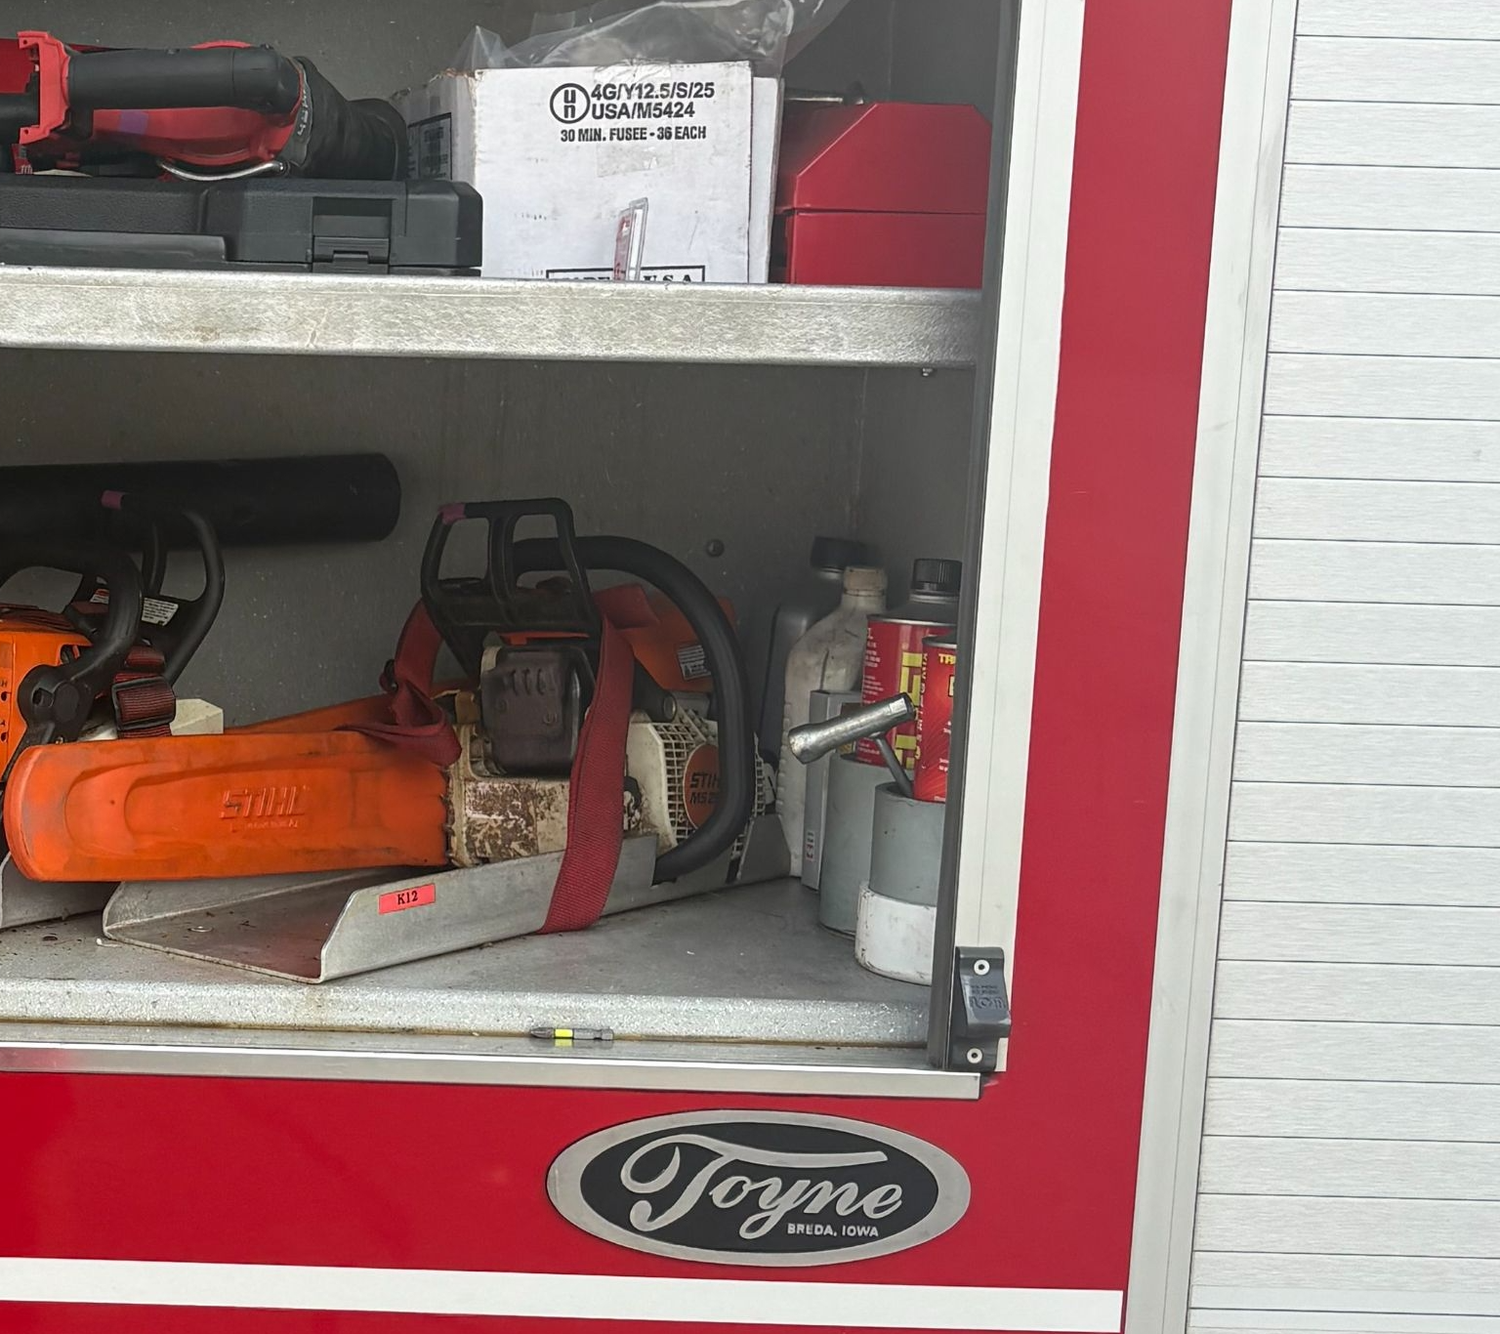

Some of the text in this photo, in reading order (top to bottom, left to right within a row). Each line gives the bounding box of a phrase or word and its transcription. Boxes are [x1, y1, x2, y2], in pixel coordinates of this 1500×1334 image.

[590, 82, 715, 101] 4G/Y12.5/S/25
[591, 101, 696, 119] USA/M5424
[560, 129, 575, 142] 30
[578, 127, 607, 142] MIN.
[609, 127, 648, 141] FUSEE
[657, 126, 672, 140] 36
[674, 125, 707, 140] EACH
[396, 890, 419, 905] K12
[619, 1133, 903, 1240] Toyne
[841, 1225, 879, 1238] IOWA
